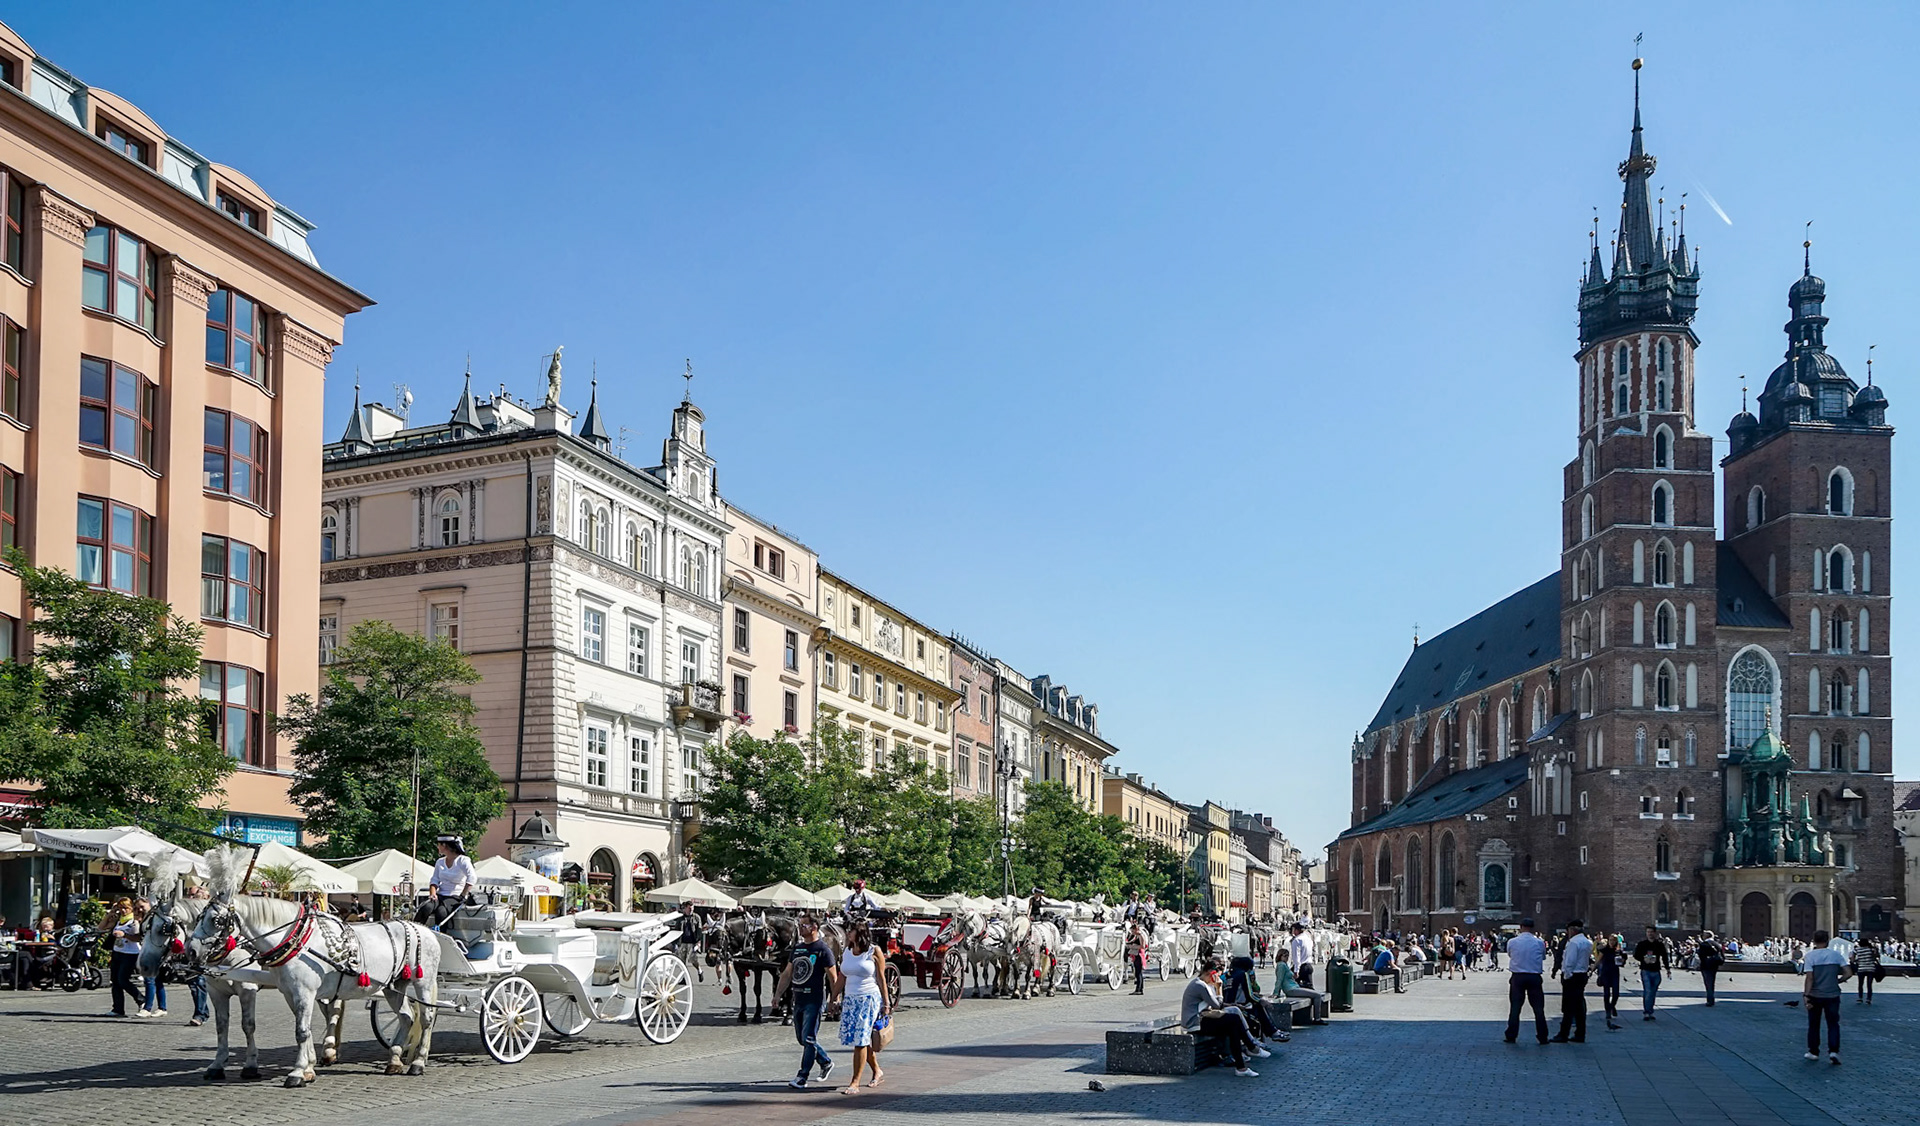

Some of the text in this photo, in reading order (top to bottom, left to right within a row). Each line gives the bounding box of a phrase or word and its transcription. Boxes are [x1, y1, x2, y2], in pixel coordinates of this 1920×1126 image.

[250, 824, 295, 834] CURRENCY
[250, 833, 294, 843] EXCHANGE
[40, 837, 100, 853] coffeeheaven
